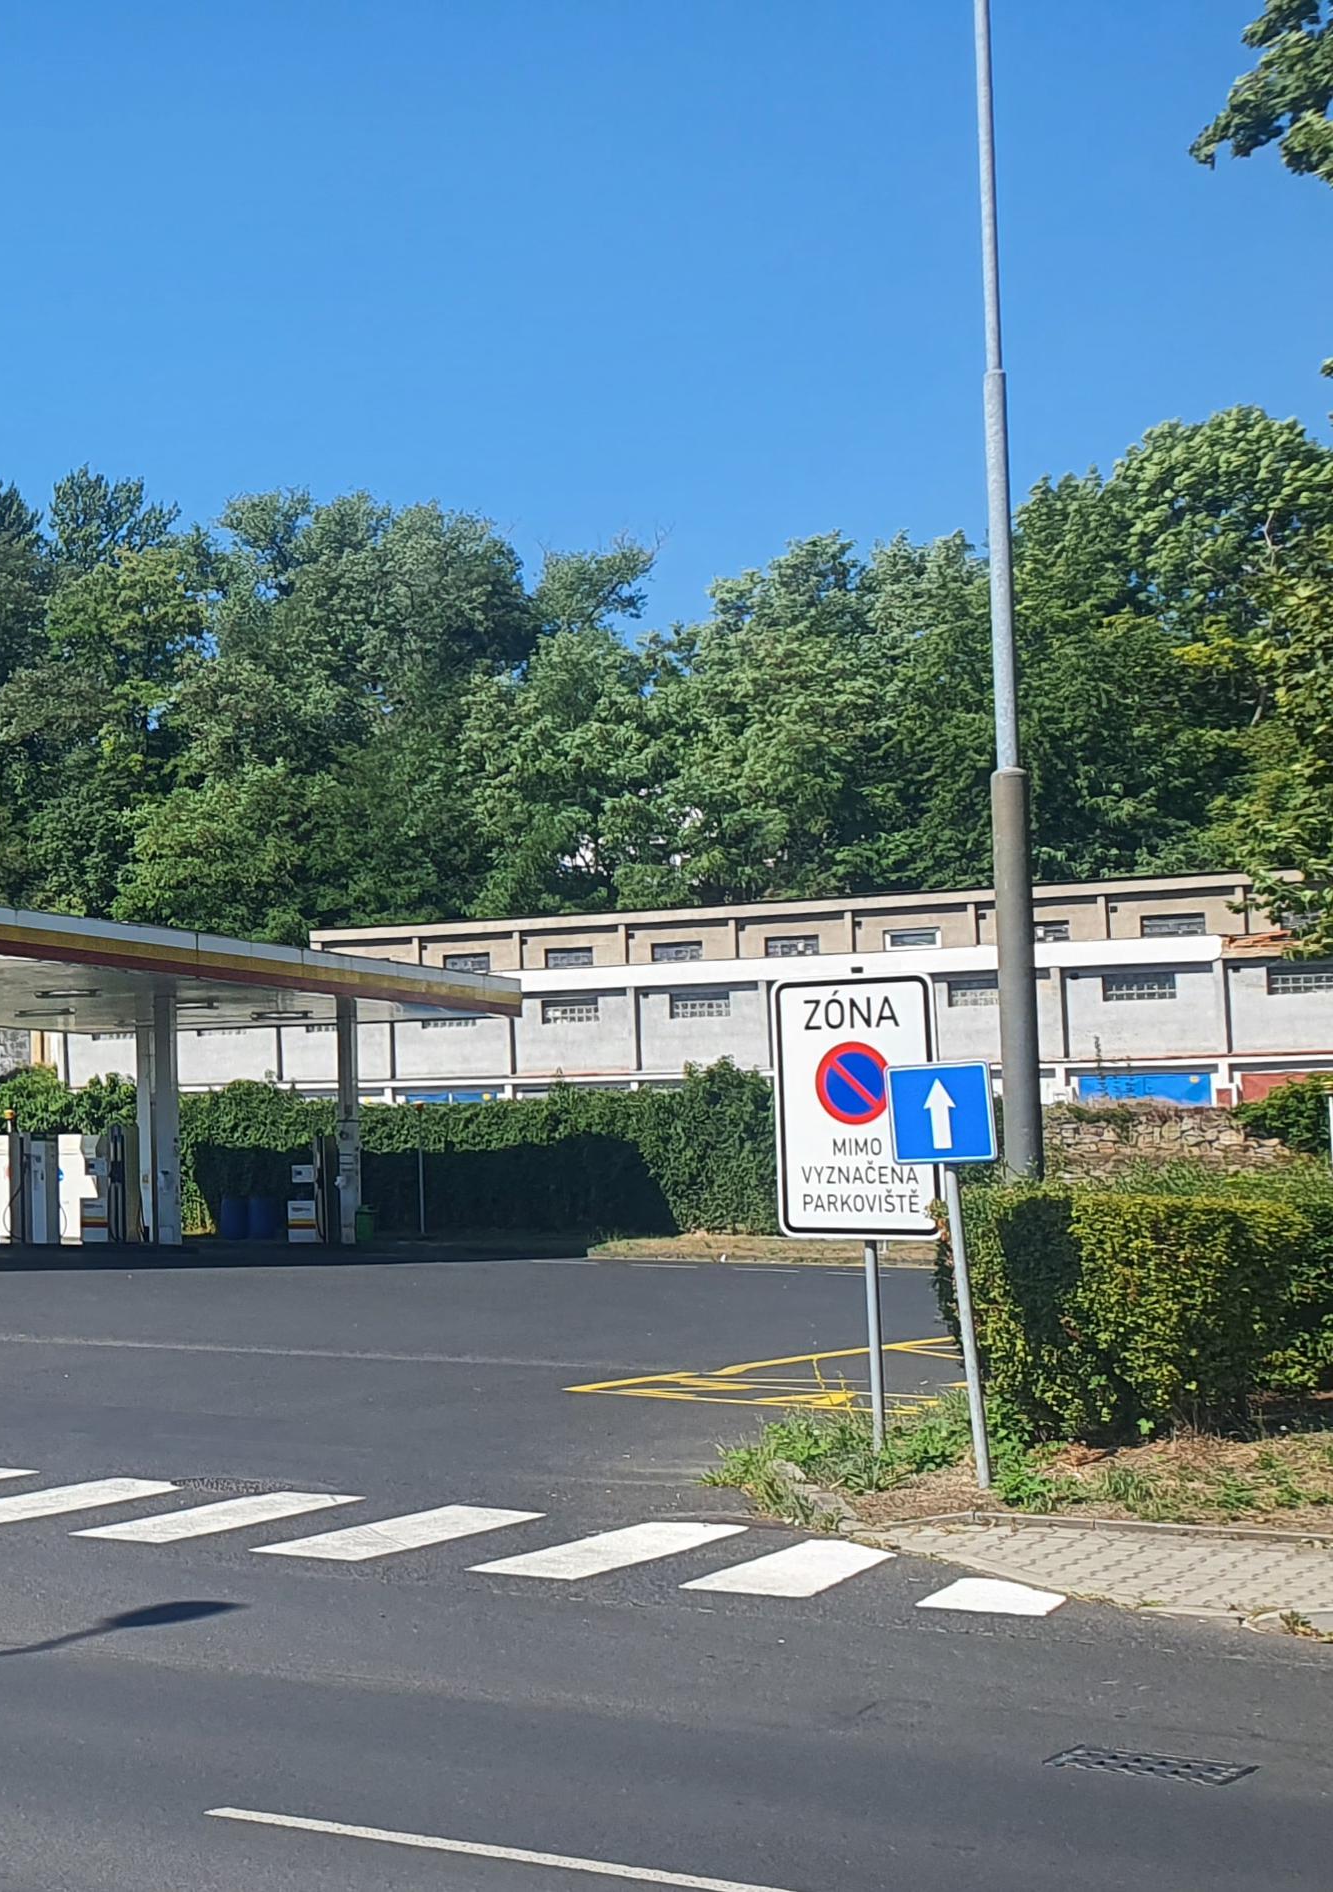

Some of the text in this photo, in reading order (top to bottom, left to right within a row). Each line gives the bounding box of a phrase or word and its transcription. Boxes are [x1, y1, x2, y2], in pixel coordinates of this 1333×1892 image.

[803, 990, 900, 1031] ZÓNA
[832, 1137, 882, 1157] MIMO
[801, 1160, 919, 1185] VYZNAČENA
[802, 1188, 921, 1214] PARKOVIŠTĚ
